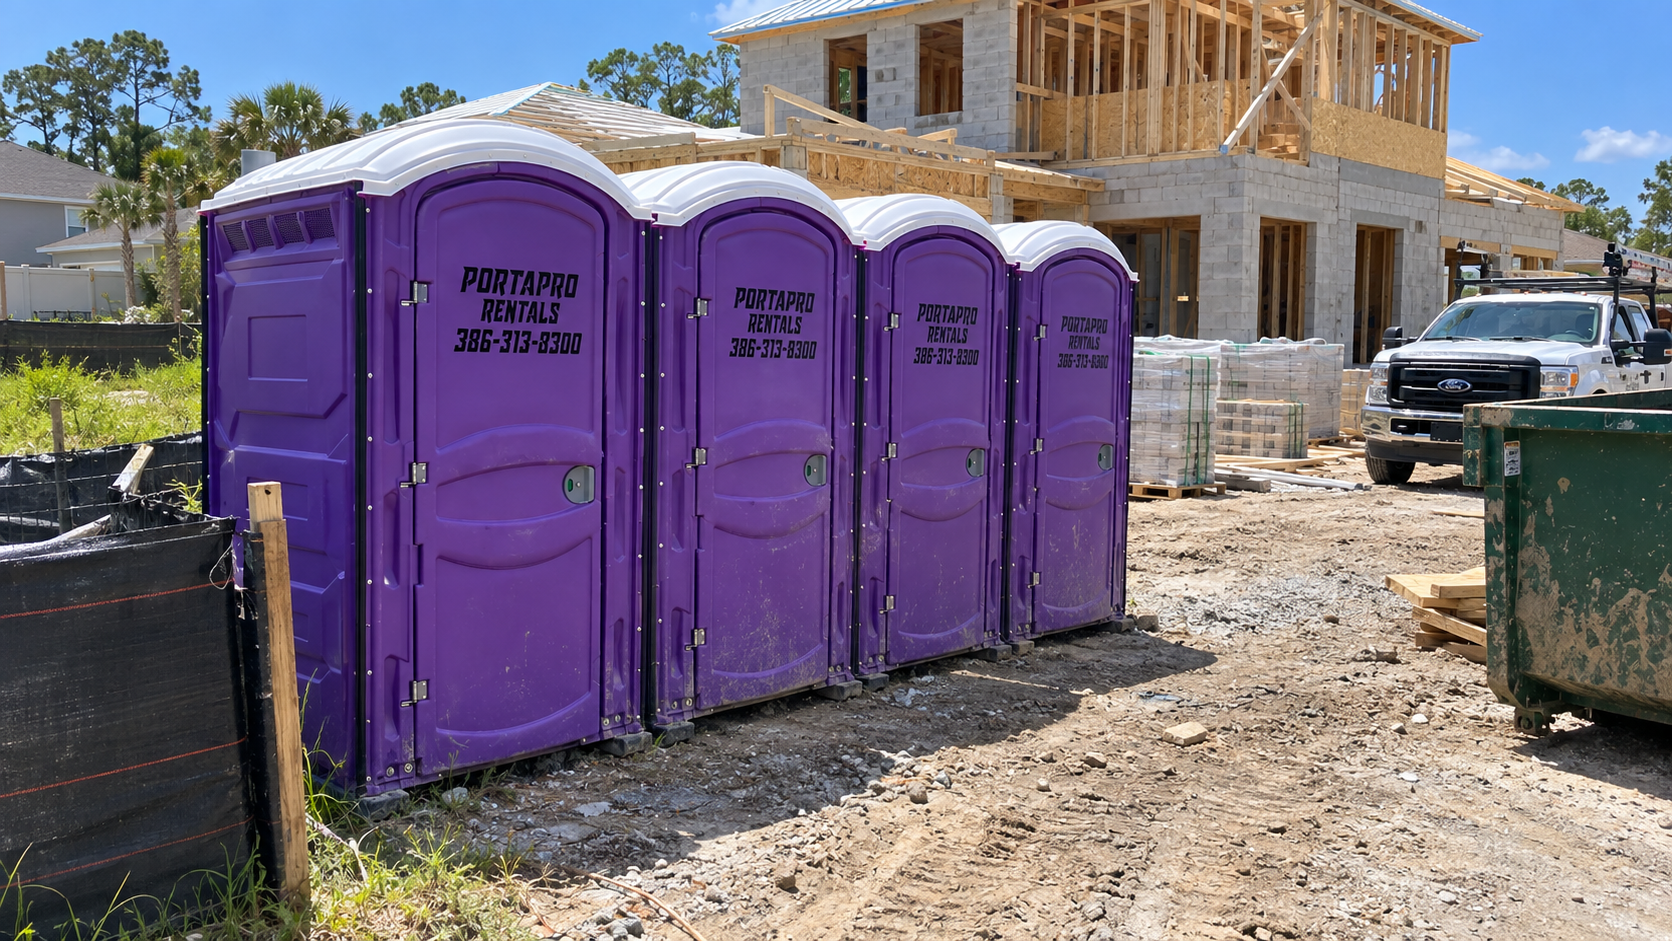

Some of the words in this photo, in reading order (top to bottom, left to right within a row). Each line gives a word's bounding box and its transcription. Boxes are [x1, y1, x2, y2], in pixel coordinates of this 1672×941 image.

[460, 266, 579, 299] PORTAPRO
[480, 298, 560, 324] RENTALS
[733, 287, 815, 314] PORTAPRO
[747, 313, 803, 334] RENTALS
[917, 303, 978, 325] PORTAPRO
[1061, 315, 1108, 334] PORTAPRO
[453, 328, 583, 355] 386-313-8300
[927, 326, 968, 344] RENTALS
[1068, 335, 1100, 350] RENTALS
[729, 338, 817, 359] 386-313-8300
[913, 347, 979, 365] 386-313-8300
